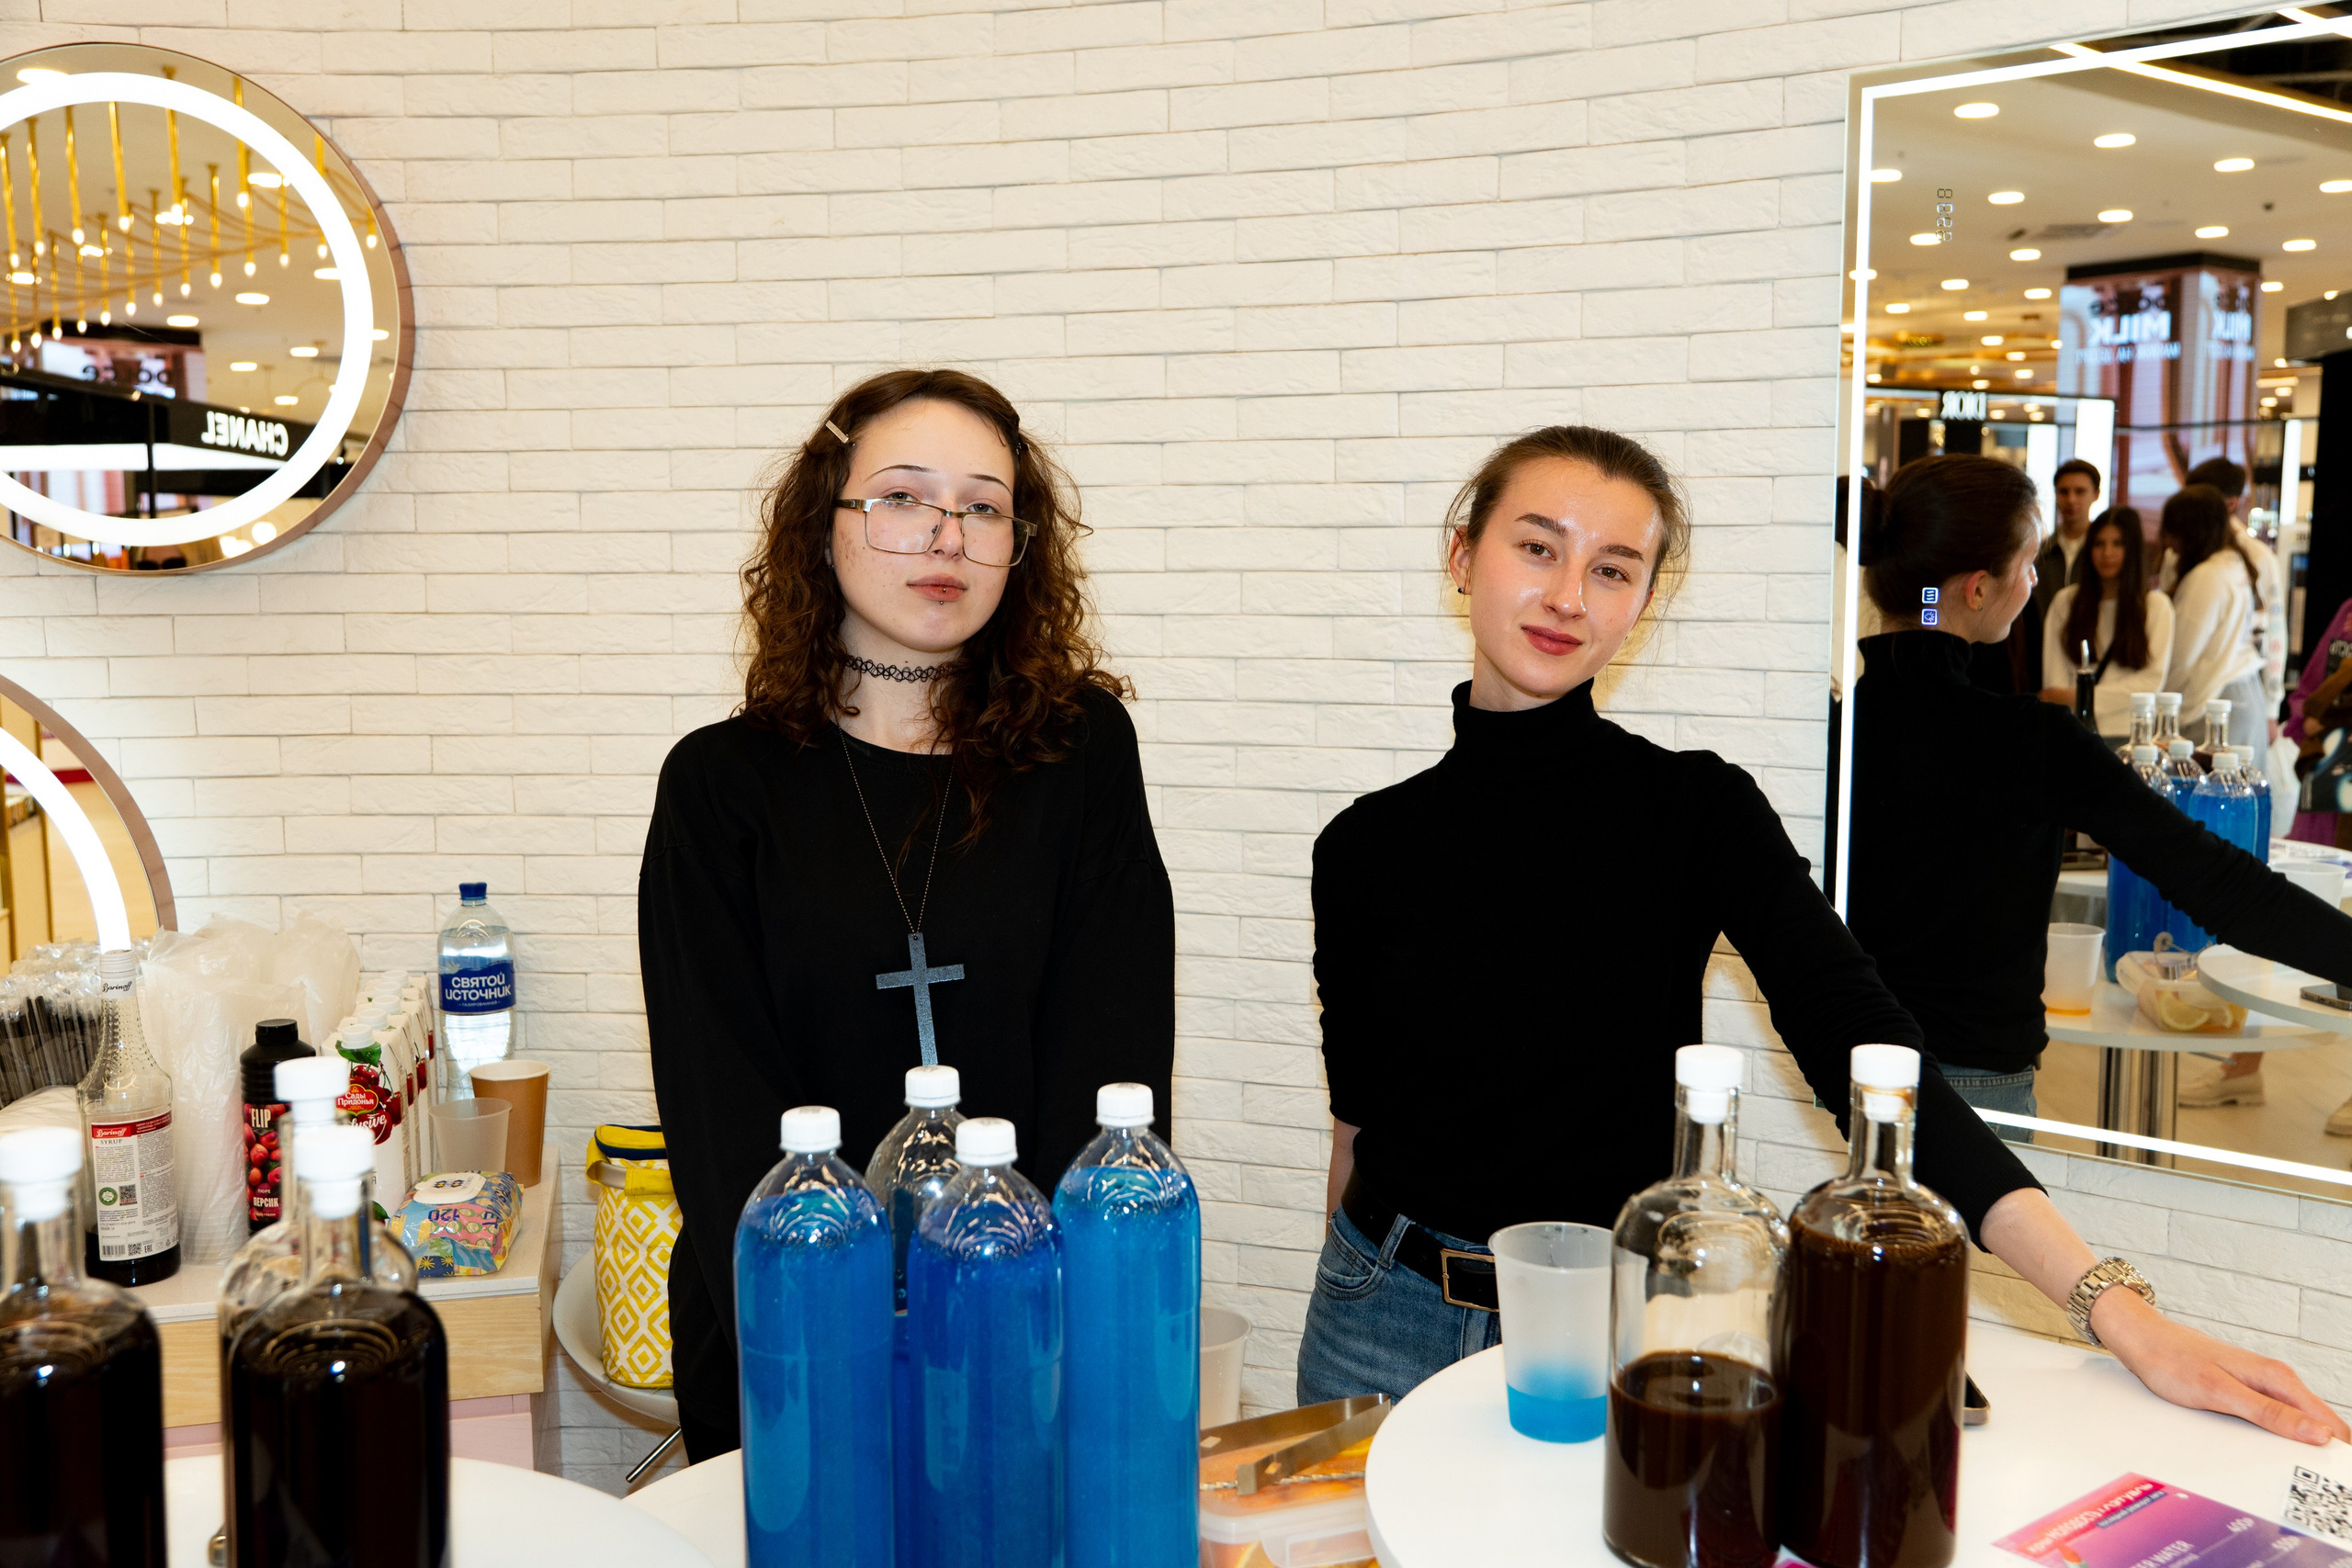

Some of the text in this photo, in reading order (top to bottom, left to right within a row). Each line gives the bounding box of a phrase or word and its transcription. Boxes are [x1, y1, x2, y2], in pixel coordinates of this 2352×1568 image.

[451, 972, 505, 988] СВЯТОЙ
[102, 981, 132, 993] Barinoff
[445, 985, 512, 1001] ИСТОЧНИК
[345, 1091, 366, 1100] Сады
[337, 1099, 374, 1107] Придонья
[251, 1108, 271, 1128] FLIP
[96, 1127, 127, 1138] Barinoff
[253, 1197, 279, 1207] ПЕРСИК
[427, 1209, 460, 1222] 120
